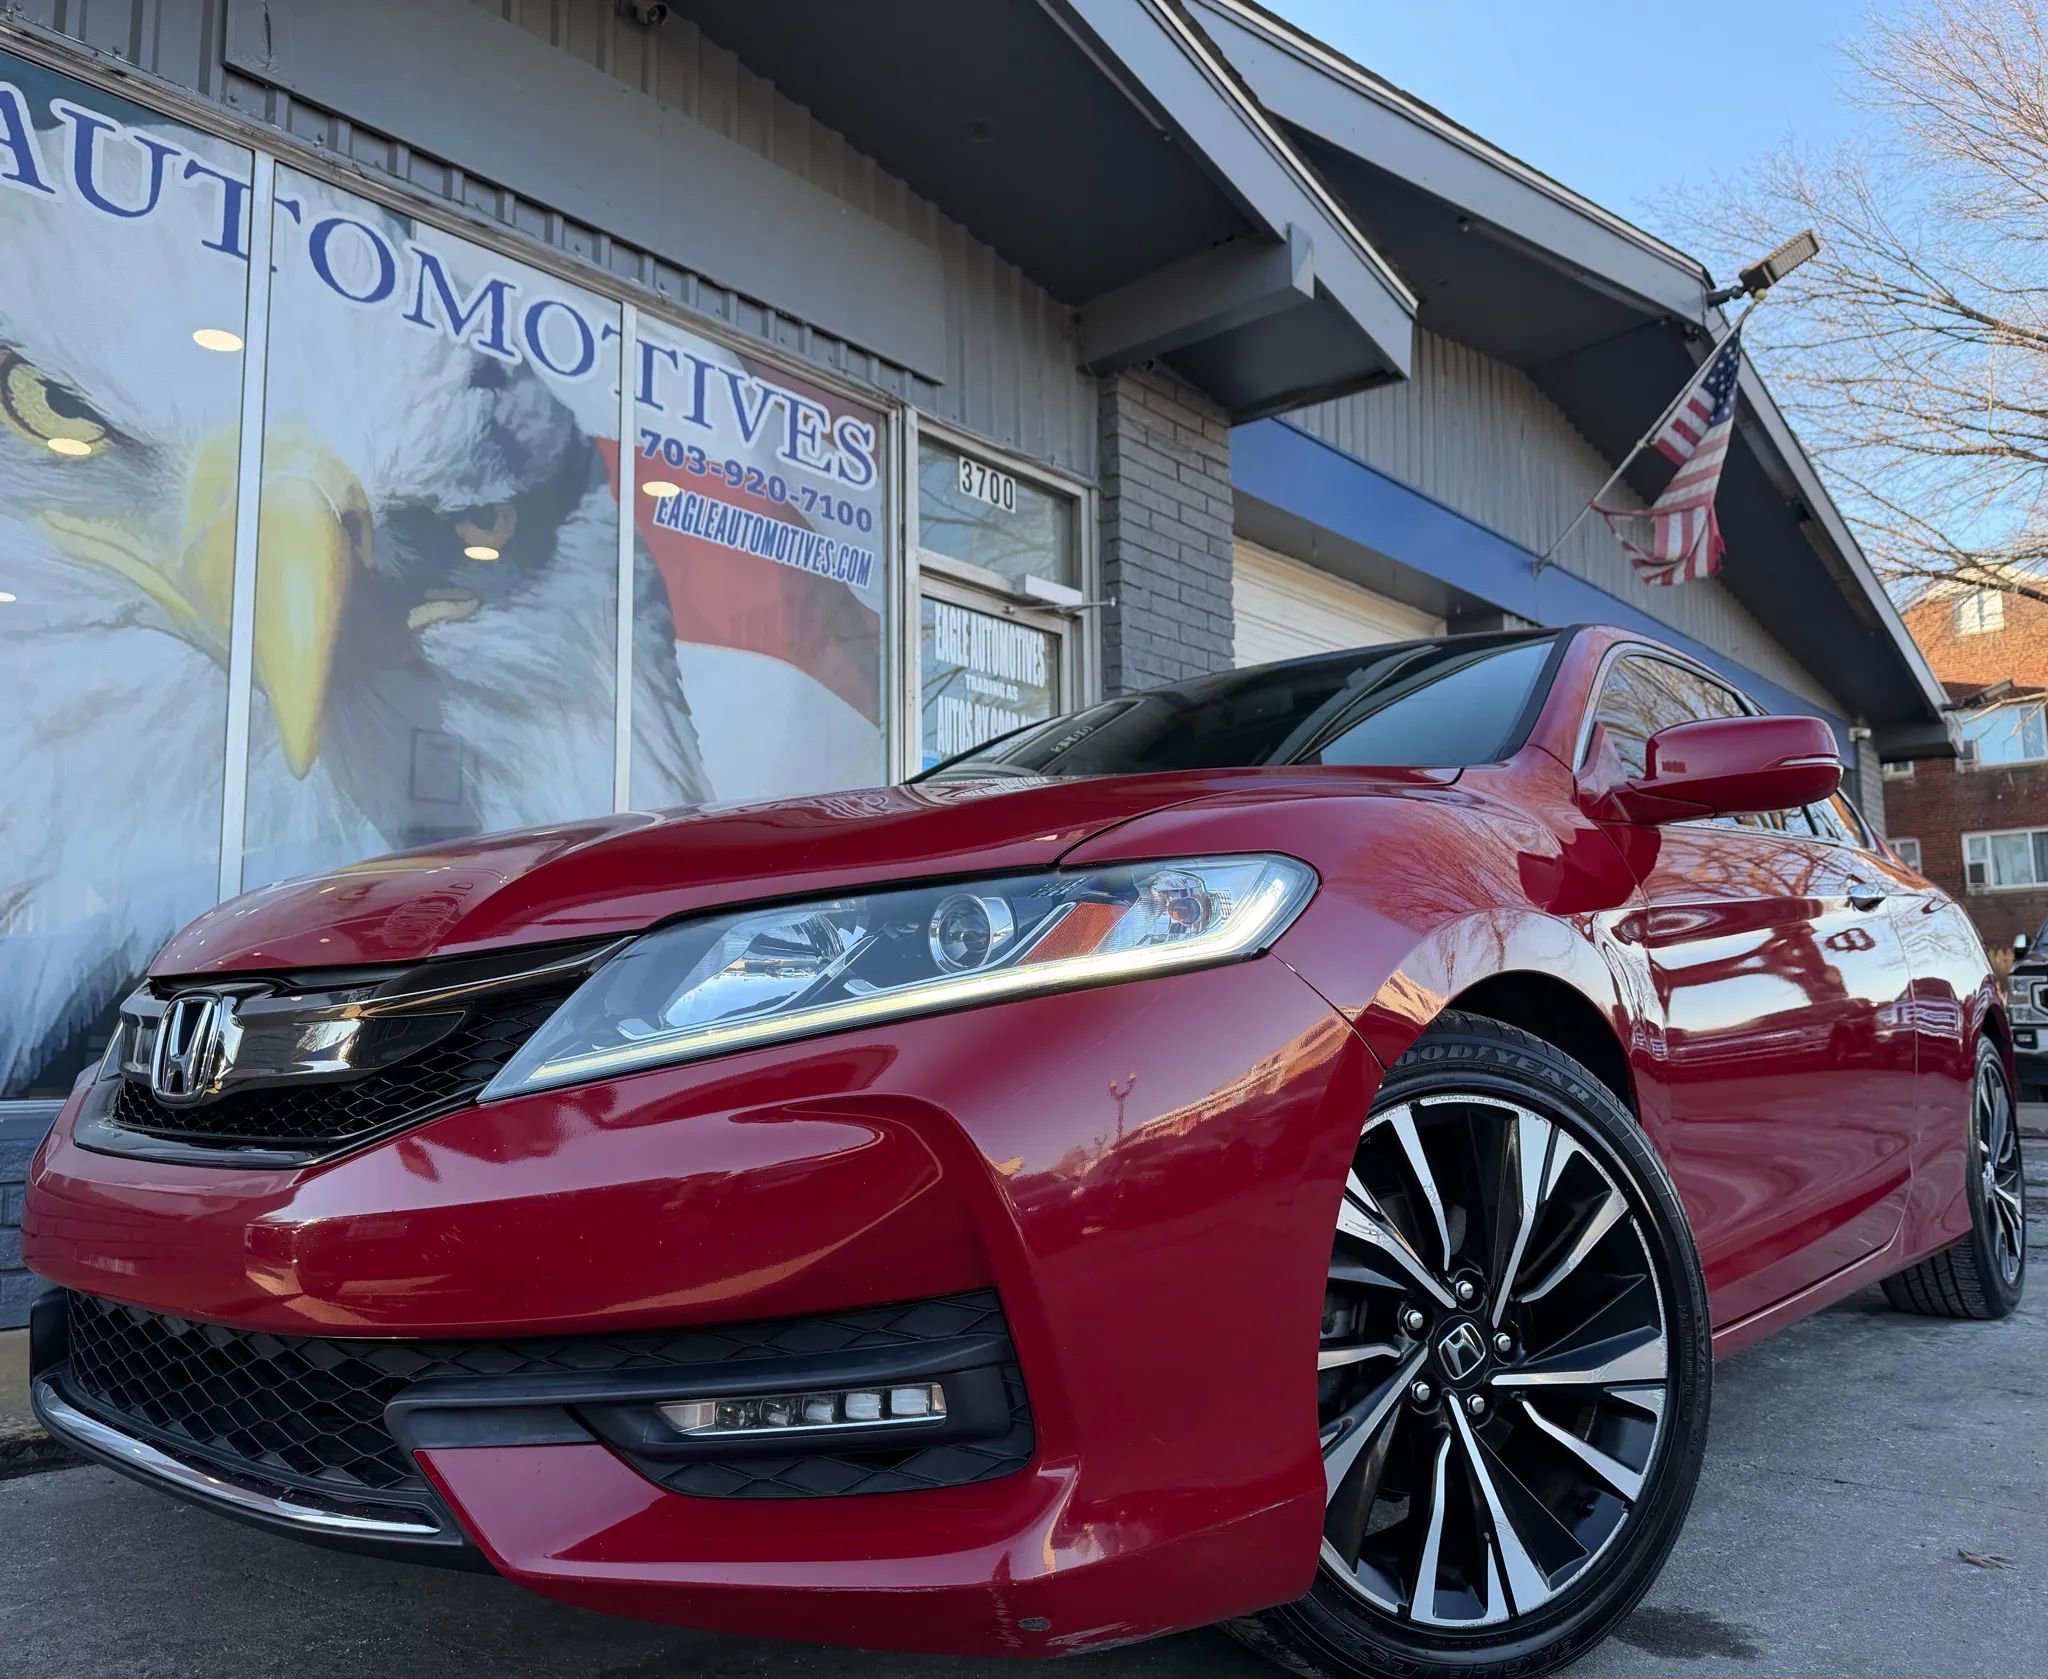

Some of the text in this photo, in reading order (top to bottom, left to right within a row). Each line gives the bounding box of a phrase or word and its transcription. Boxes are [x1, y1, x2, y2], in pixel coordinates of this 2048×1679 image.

[640, 427, 873, 533] 703-920-7100
[962, 460, 1013, 510] 3700
[655, 491, 873, 587] EAGLEAUTOMOTIVES.COM
[935, 602, 1046, 688] EAGLE AUTOMOTIVES
[1006, 684, 1019, 701] AS
[936, 694, 974, 756] AUTOS
[1394, 1043, 1591, 1102] OODYEAR
